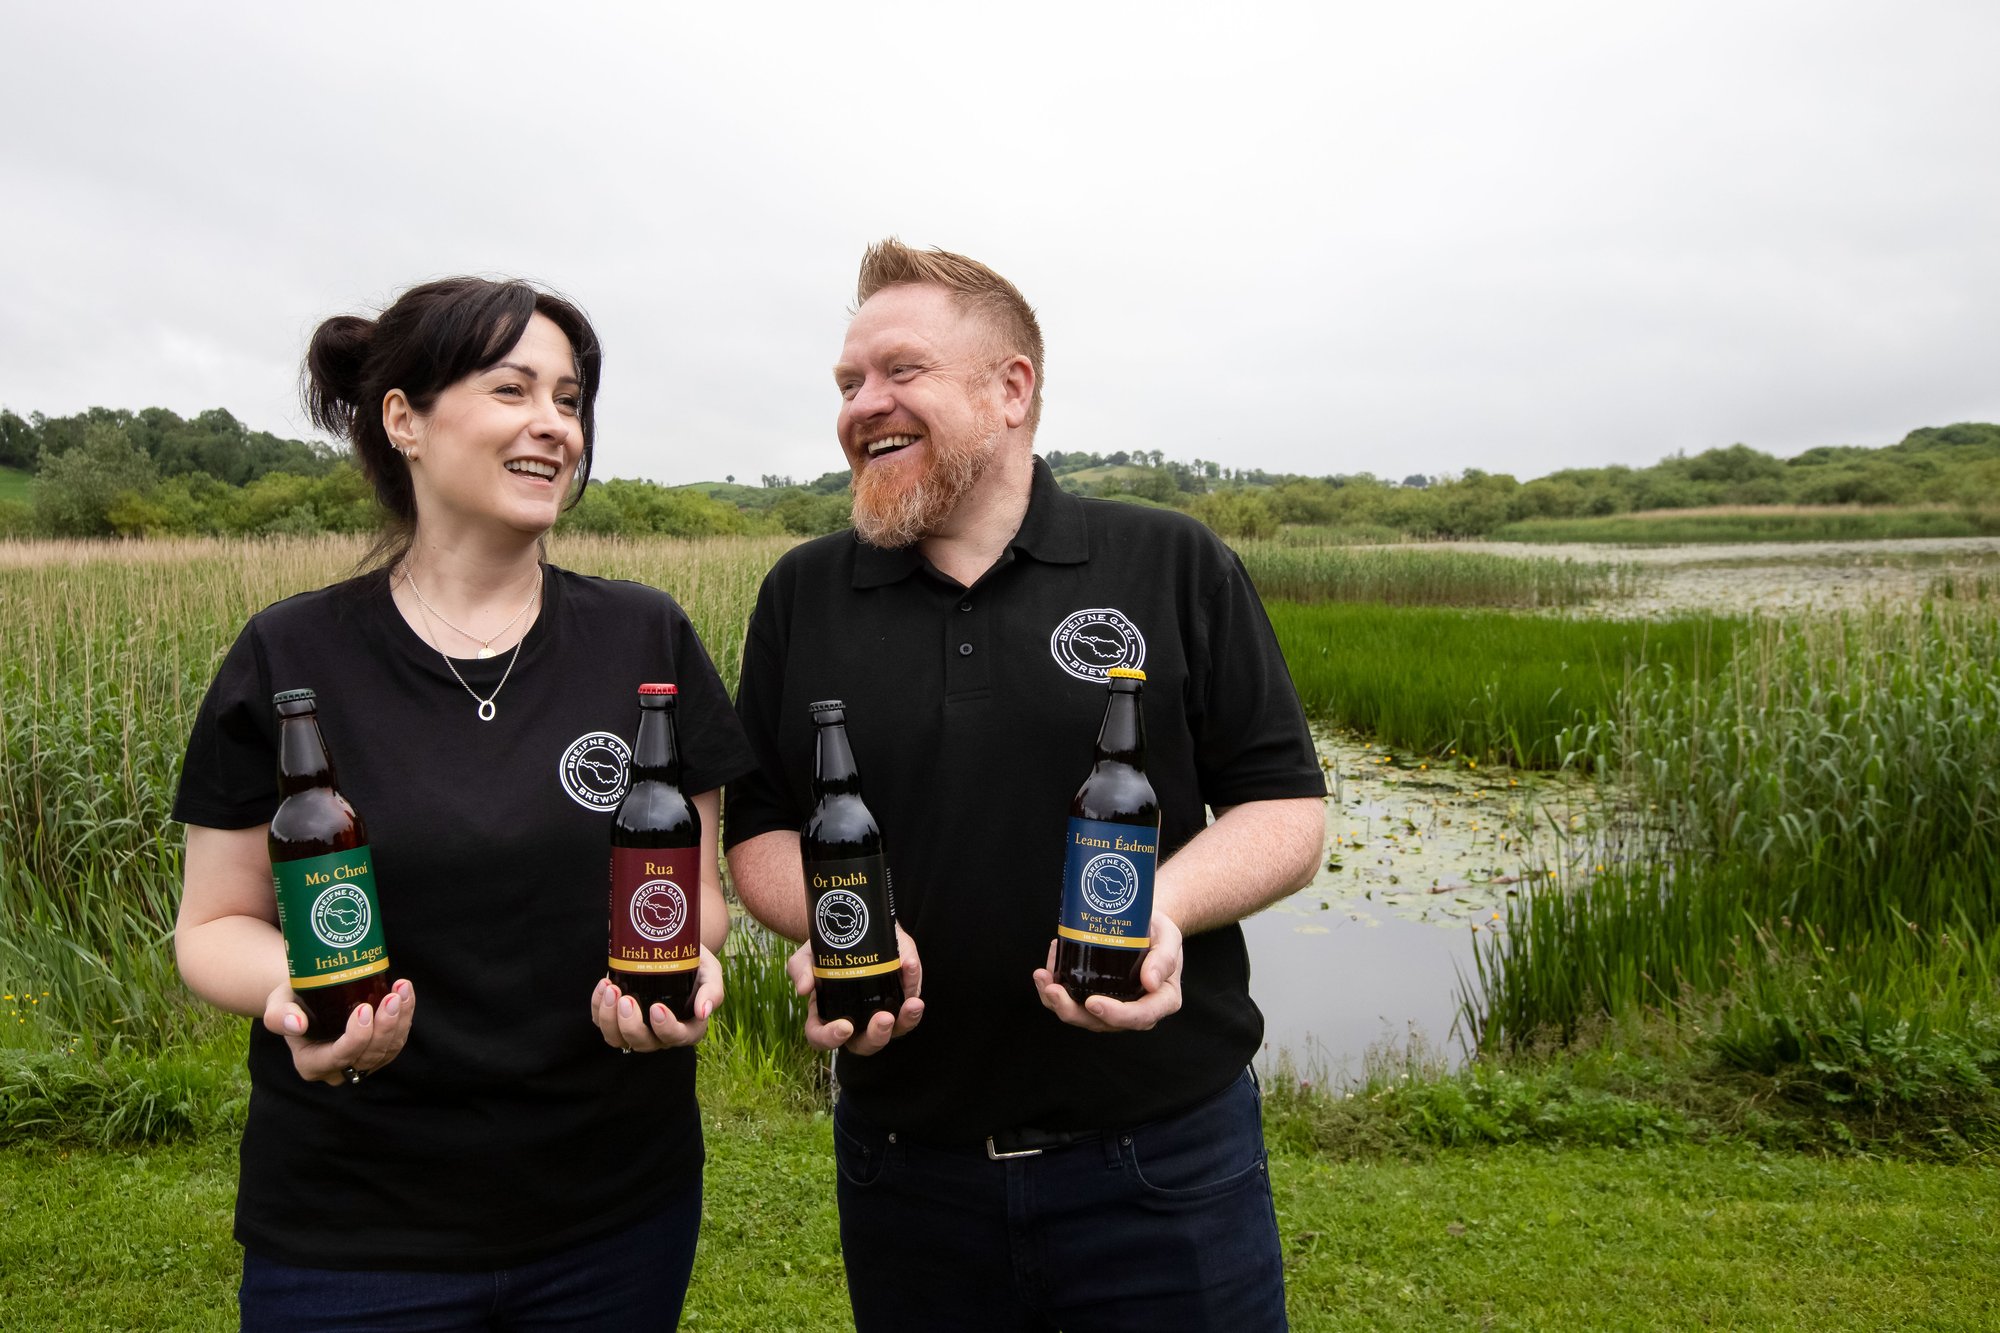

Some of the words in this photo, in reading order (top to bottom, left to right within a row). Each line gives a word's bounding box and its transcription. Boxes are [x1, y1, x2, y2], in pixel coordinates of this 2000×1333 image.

[1060, 614, 1106, 641] BRÉIFNE
[1110, 617, 1135, 643] GAEL
[1070, 660, 1130, 676] BREWG
[567, 738, 605, 768] BRÉIFNE
[608, 741, 628, 767] GAEL
[578, 787, 625, 803] BREWING
[1075, 833, 1110, 849] Leann
[1114, 835, 1155, 853] Éadrom
[305, 872, 330, 886] Mo
[334, 861, 368, 880] Chroí
[645, 862, 673, 875] Rua
[1120, 863, 1133, 883] GAEL
[813, 873, 828, 888] Ór
[830, 872, 867, 887] Dubh
[348, 890, 365, 908] GAEL
[667, 886, 682, 907] GAEL
[1089, 895, 1127, 909] BREWING
[846, 896, 863, 915] GAEL
[1080, 912, 1102, 923] West
[1104, 915, 1132, 927] Cavan
[326, 925, 365, 942] BREWING
[640, 922, 678, 935] BREWING
[825, 929, 860, 943] BREWING
[1088, 923, 1107, 933] Pale
[1109, 926, 1124, 936] Ale
[315, 952, 349, 970] Irish
[352, 946, 383, 962] Lager
[622, 946, 649, 959] Irish
[653, 945, 679, 959] Red
[681, 943, 696, 958] Ale
[818, 953, 842, 966] Irish
[845, 953, 879, 965] Stout
